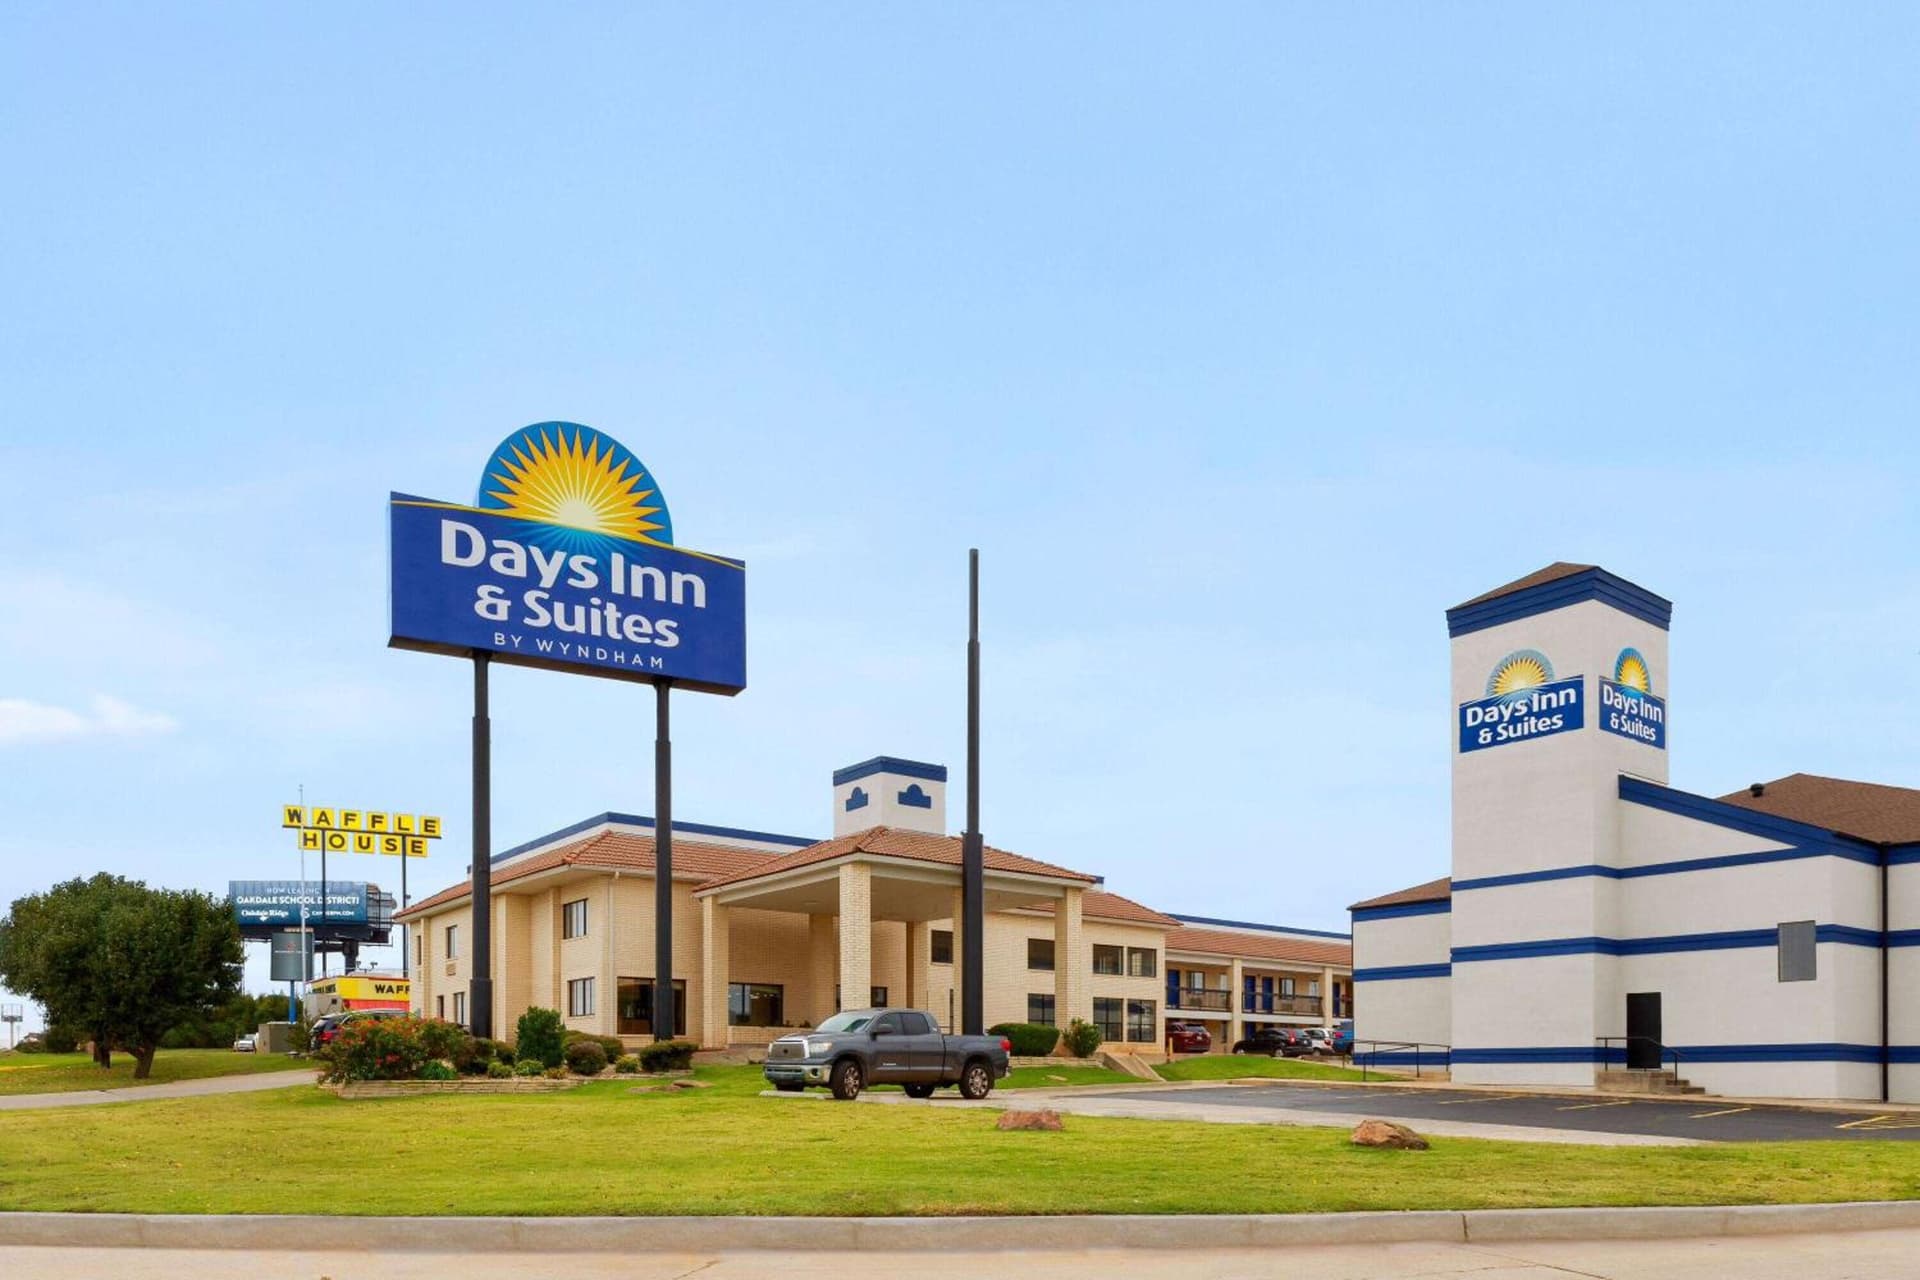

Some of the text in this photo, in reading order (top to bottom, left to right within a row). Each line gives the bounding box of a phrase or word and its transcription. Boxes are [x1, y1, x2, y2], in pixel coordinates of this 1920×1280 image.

[441, 518, 706, 608] Days Inn
[474, 584, 679, 648] & Suites
[494, 632, 664, 669] BY WYNDHAM
[1466, 687, 1577, 727] Days Inn
[1603, 684, 1662, 723] Days Inn
[1478, 714, 1564, 744] & Suites
[1610, 714, 1656, 741] & Suites
[287, 808, 437, 833] WAFFLE
[302, 832, 424, 854] HOUSE
[236, 895, 278, 905] OAKDALE
[279, 895, 315, 905] SCHOOL
[287, 887, 320, 895] LEAING
